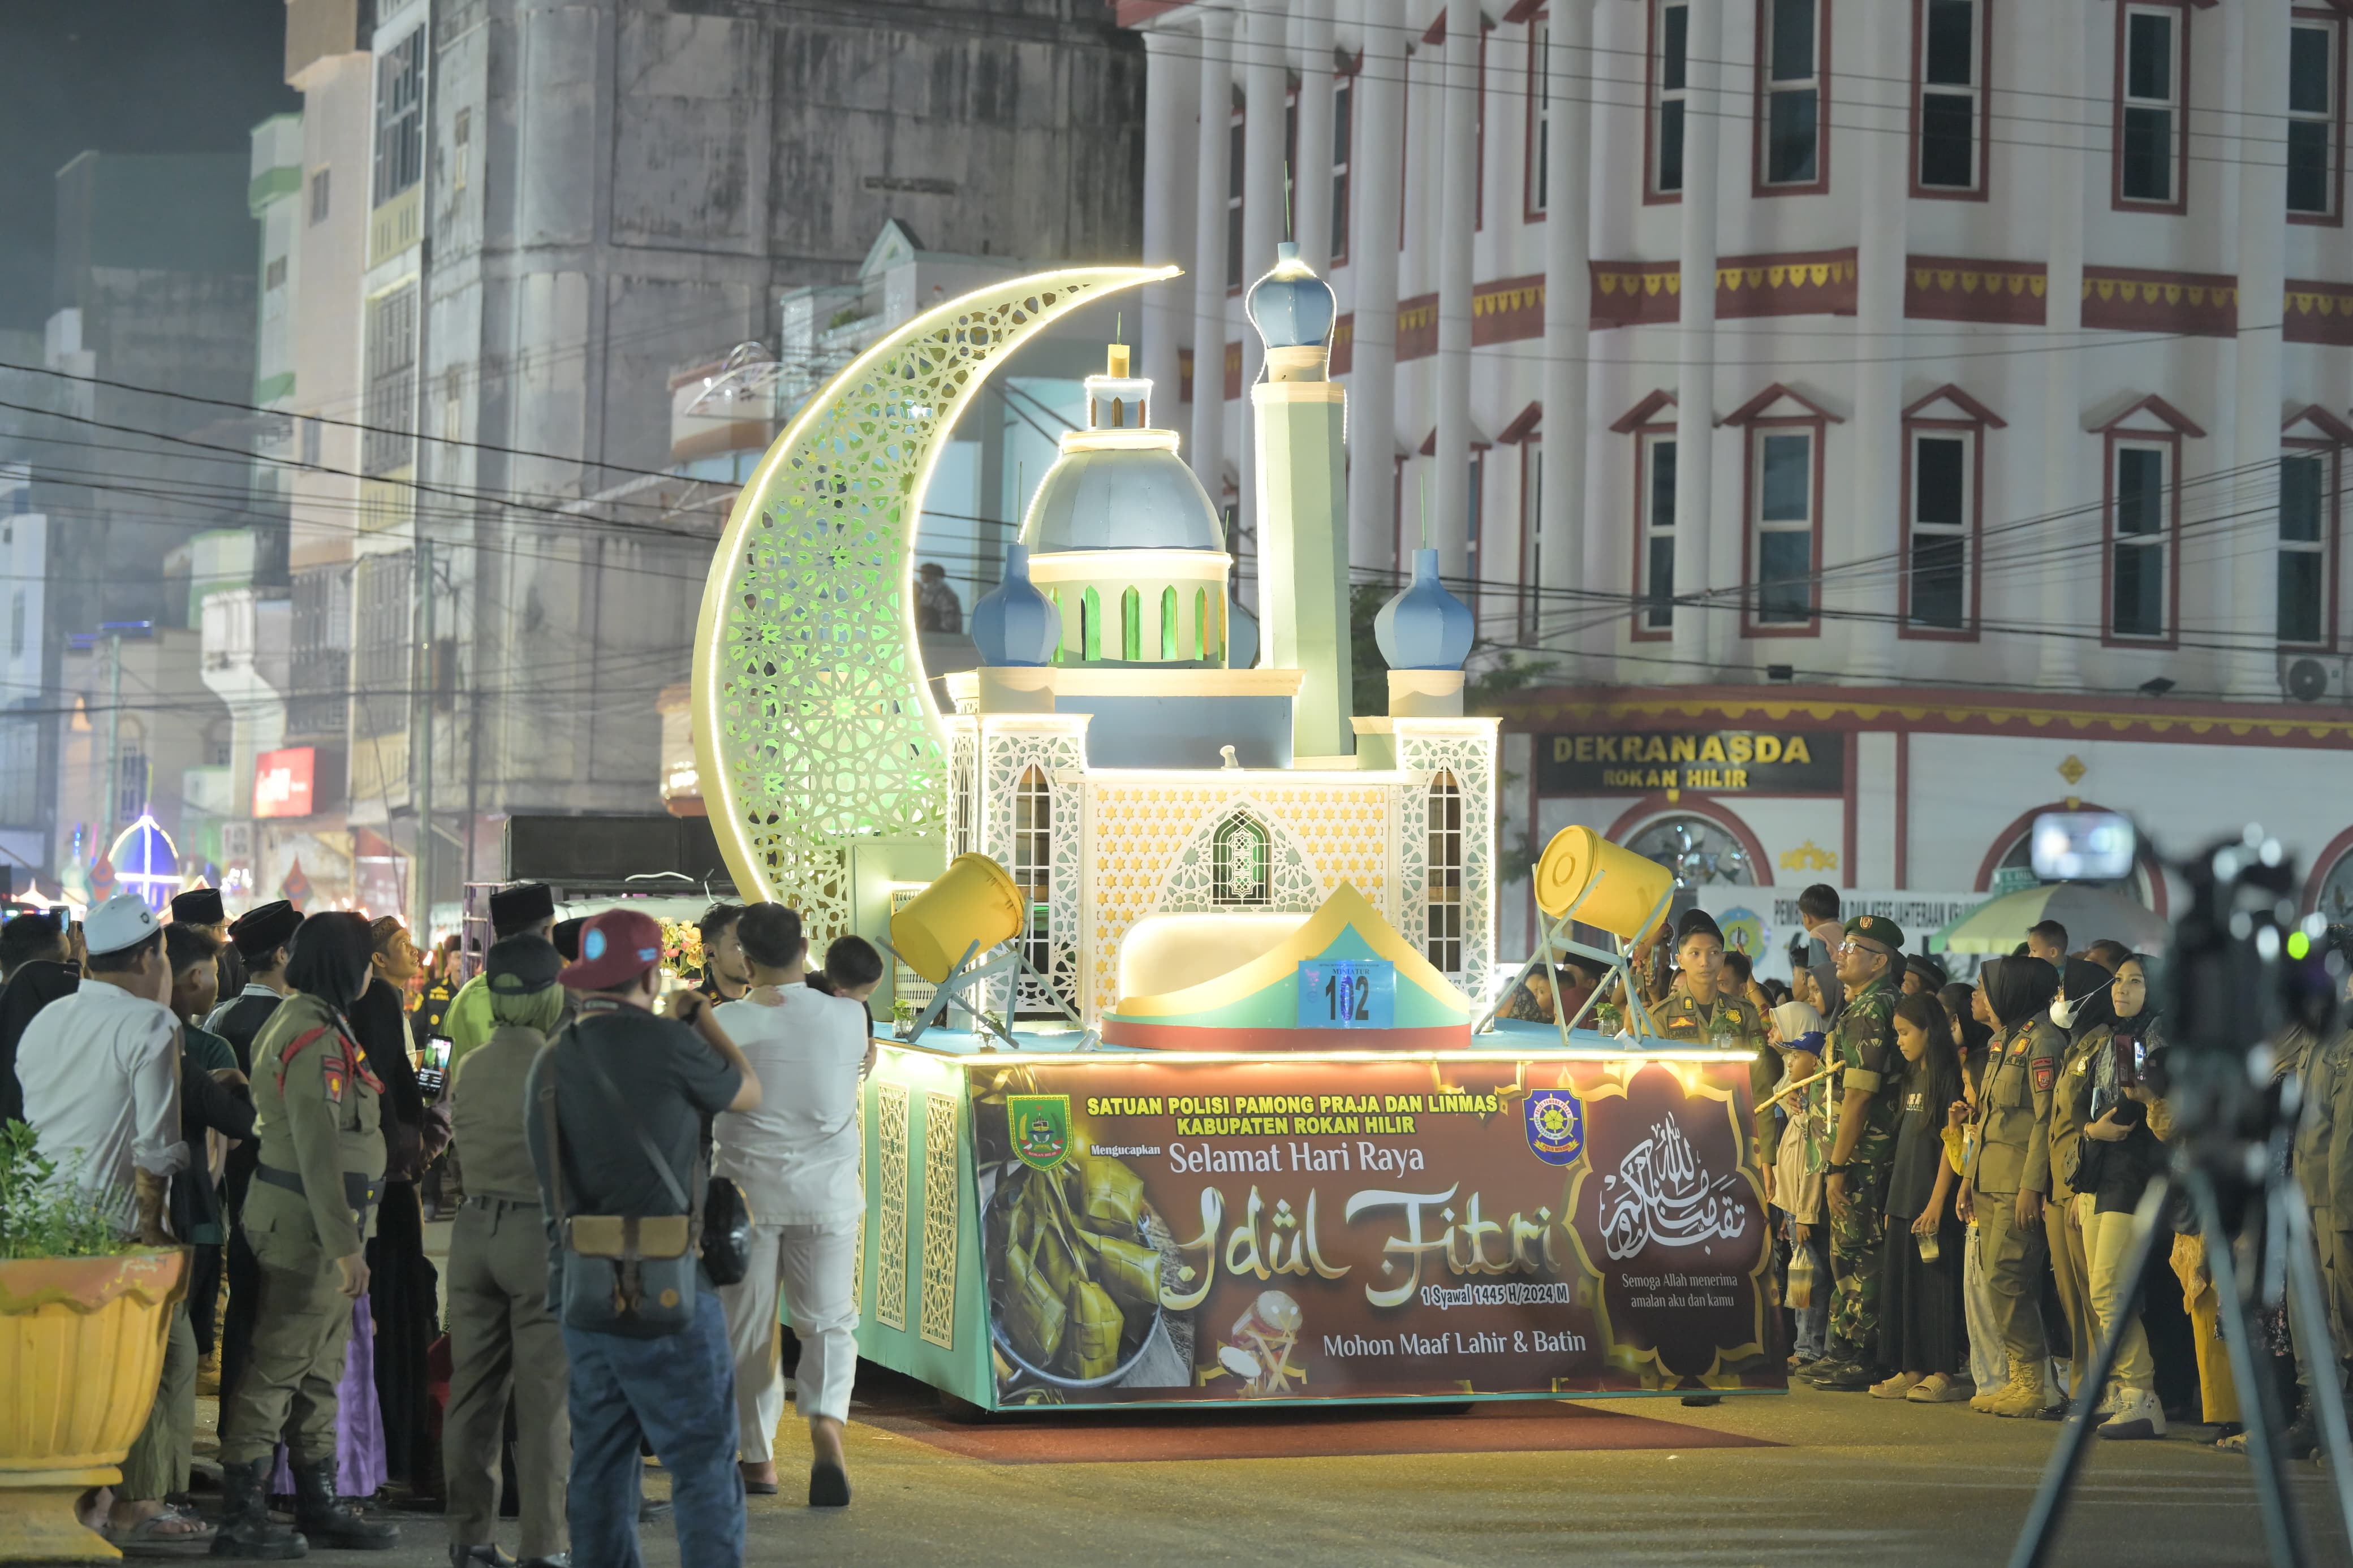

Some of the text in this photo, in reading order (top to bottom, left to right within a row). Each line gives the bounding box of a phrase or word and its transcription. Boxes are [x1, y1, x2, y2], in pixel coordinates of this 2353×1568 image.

[1553, 735, 1810, 763] DEKRANASDA
[1603, 768, 1747, 788] ROKAN HILIR
[1325, 975, 1369, 1021] 102
[1087, 1095, 1498, 1115] SATUAN POLISI PAMONG PRAJA DAN LINMAS
[1177, 1116, 1416, 1135] KABUPATEN ROKAN HILIR
[1091, 1144, 1161, 1157] Mengucapkan
[1169, 1142, 1424, 1178] Selamat Hari Raya
[1346, 1181, 1561, 1307] Fitri
[1622, 1273, 1738, 1290] Semoga Allah menerima
[1421, 1283, 1569, 1309] 1 Syawal 1445 H/2024 M
[1631, 1293, 1734, 1307] amalan aku dan kamu
[1324, 1331, 1586, 1357] Mohon Maaf Lahir & Batin
